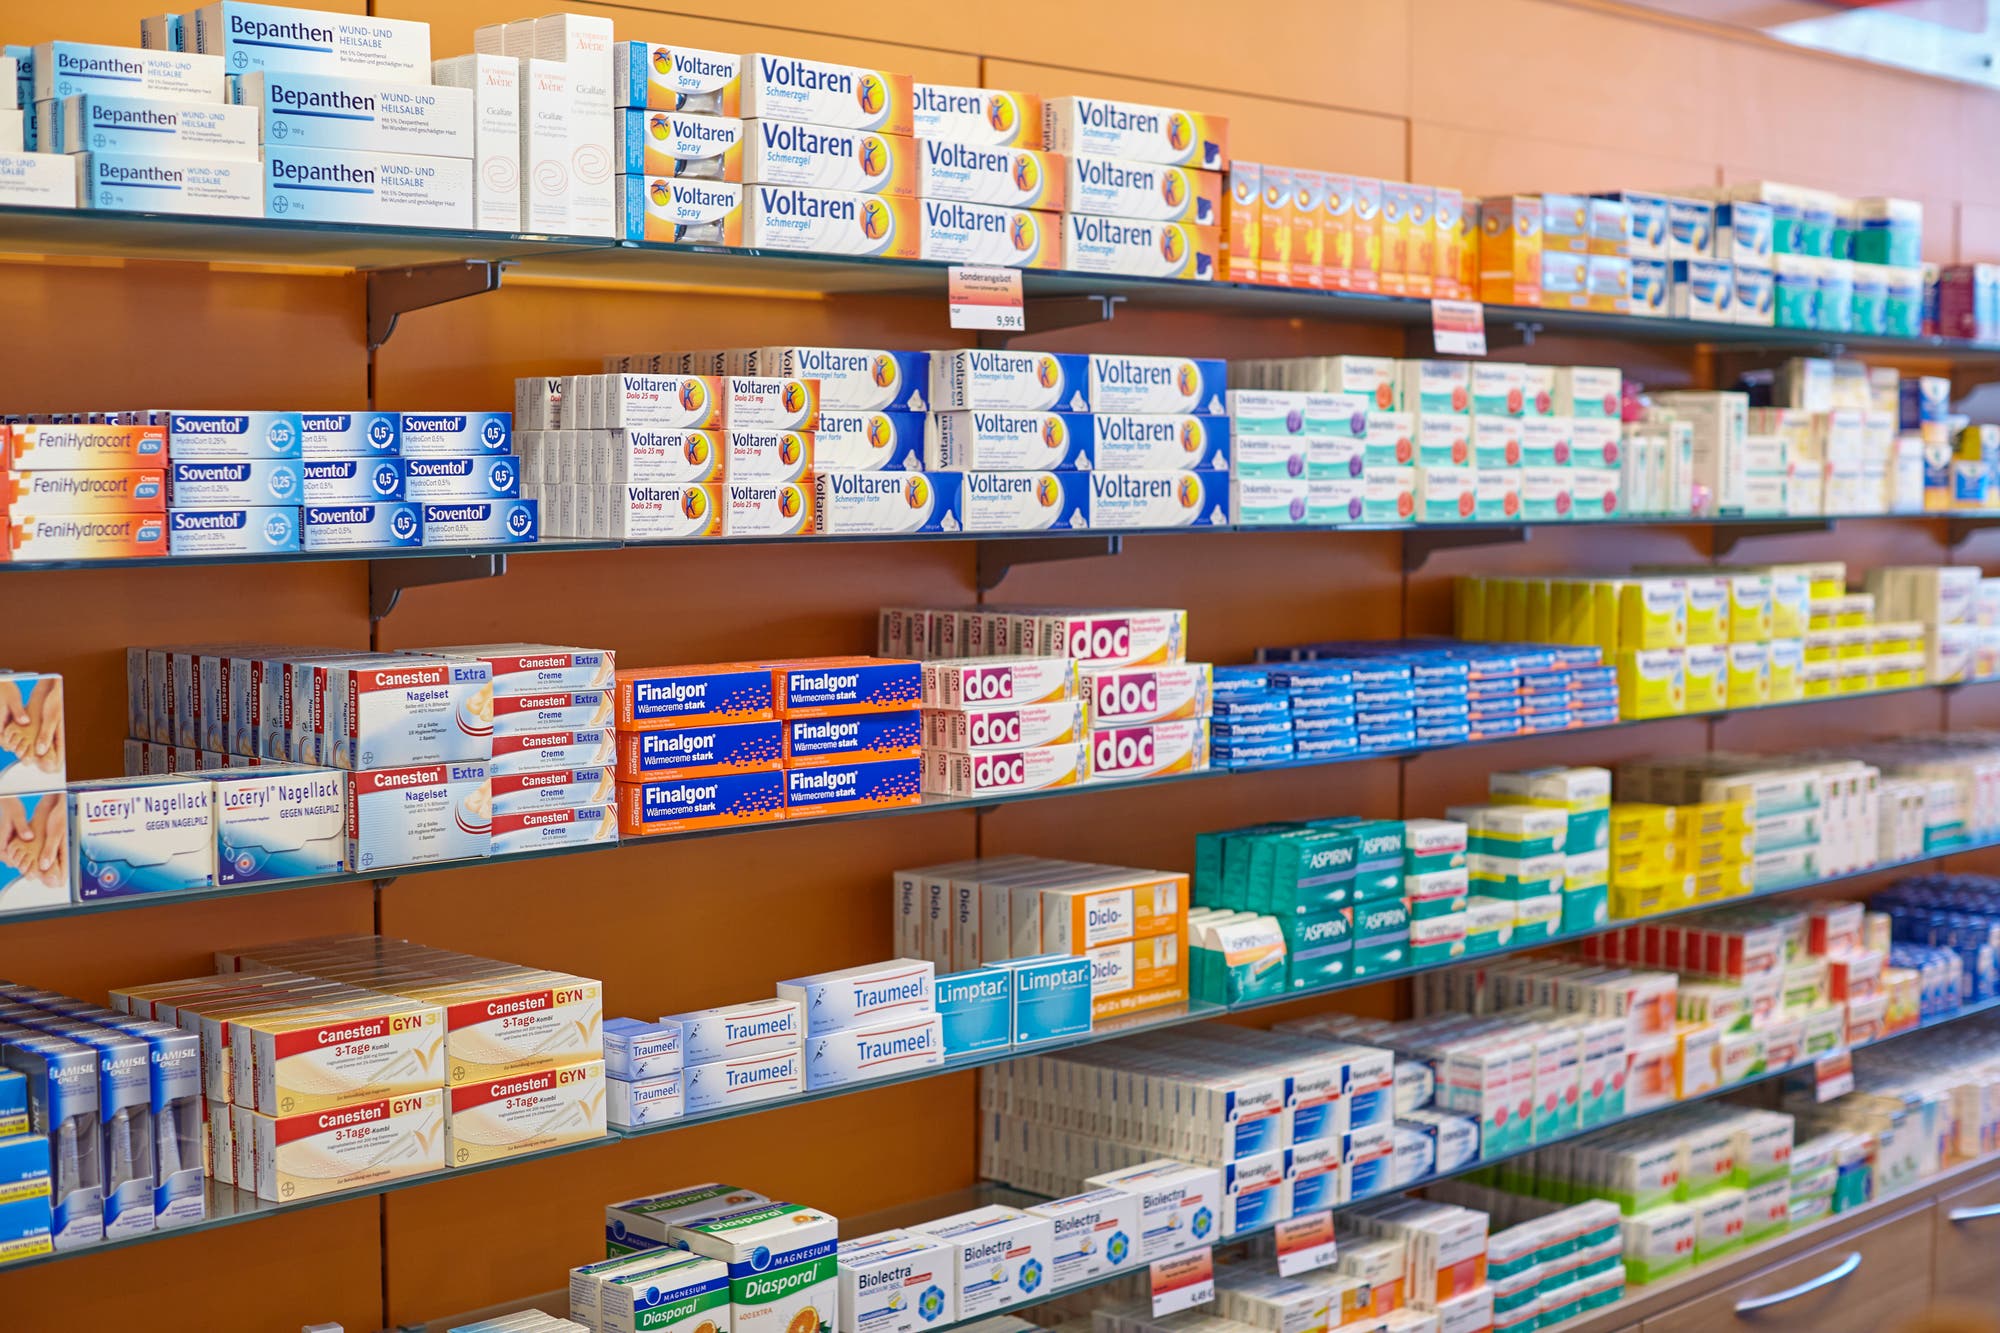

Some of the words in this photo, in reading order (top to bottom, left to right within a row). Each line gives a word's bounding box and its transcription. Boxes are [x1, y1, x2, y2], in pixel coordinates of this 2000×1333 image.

[231, 16, 334, 43] Bepanthen
[339, 25, 370, 37] WUND-
[373, 29, 392, 39] UND
[339, 37, 382, 48] HEILSALBE
[58, 54, 143, 75] Bepanthen
[674, 55, 733, 78] Voltaren
[678, 76, 700, 89] Spray
[761, 57, 851, 94] Voltaren
[272, 85, 374, 110] Bepanthen
[381, 92, 413, 103] WUND-
[415, 96, 435, 105] UND
[766, 85, 810, 102] Schmerzgel
[914, 87, 981, 115] oltaren
[93, 106, 177, 125] Bepanthen
[381, 104, 425, 116] HEILSALBE
[1079, 101, 1159, 133] Voltaren
[673, 120, 735, 143] Voltaren
[763, 123, 853, 158] Voltaren
[767, 151, 811, 167] Schmerzgel
[928, 141, 1008, 173] Voltaren
[100, 163, 182, 182] Bepanthen
[272, 159, 374, 183] Bepanthen
[931, 168, 971, 181] Schmerzgel
[1077, 159, 1154, 190] Voltaren
[673, 186, 734, 207] Voltaren
[763, 188, 855, 221] Voltaren
[677, 207, 700, 219] Spray
[927, 202, 1005, 233] Voltaren
[1073, 216, 1152, 246] Voltaren
[960, 272, 1011, 283] Sonderangebot
[997, 316, 1014, 327] 9,99
[1017, 317, 1021, 326] €
[799, 350, 867, 371] Voltaren
[970, 353, 1032, 373] Voltaren
[1096, 360, 1171, 384] Voltaren
[624, 378, 677, 393] Voltaren
[733, 381, 780, 393] Voltaren
[650, 394, 658, 402] mg
[177, 416, 240, 433] Soventol
[406, 418, 458, 431] Soventol
[975, 414, 1037, 433] Voltaren
[1099, 418, 1174, 441] Voltaren
[39, 432, 132, 450] FeniHydrocort
[631, 432, 681, 447] Voltaren
[732, 433, 778, 448] Voltaren
[179, 463, 237, 481] Soventol
[411, 461, 464, 475] Soventol
[34, 477, 127, 495] FeniHydrocort
[731, 487, 776, 500] Voltaren
[831, 475, 900, 495] Voltaren
[968, 475, 1031, 493] Voltaren
[1093, 475, 1171, 497] Voltaren
[629, 488, 679, 501] Voltaren
[835, 495, 865, 503] Schmerzgel
[177, 511, 239, 529] Soventol
[310, 508, 366, 524] Soventol
[428, 505, 483, 520] Soventol
[37, 521, 130, 539] FeniHydrocort
[1071, 622, 1129, 659] doc
[519, 656, 565, 669] Canesten
[575, 655, 598, 665] Extra
[375, 672, 440, 686] Canesten
[455, 668, 486, 681] Extra
[538, 671, 562, 680] Creme
[791, 674, 856, 694] Finalgon
[407, 689, 448, 701] Nagelset
[638, 683, 704, 705] Finalgon
[965, 670, 1011, 701] doc
[520, 696, 565, 708] Canesten
[575, 694, 598, 704] Extra
[1099, 676, 1156, 715] doc
[538, 710, 562, 719] Creme
[638, 702, 683, 713] Wärmecreme
[684, 700, 705, 710] stark
[794, 723, 858, 743] Finalgon
[972, 713, 1019, 744] doc
[522, 734, 566, 747] Canesten
[644, 734, 712, 755] Finalgon
[1095, 730, 1153, 770] doc
[541, 749, 564, 758] Creme
[374, 771, 438, 788] Canesten
[452, 767, 484, 780] Extra
[522, 772, 566, 785] Canesten
[791, 771, 855, 792] Finalgon
[224, 788, 270, 808] Loceryl
[279, 780, 338, 804] Nagellack
[405, 789, 447, 801] Nagelset
[646, 785, 715, 806] Finalgon
[86, 799, 135, 820] Loceryl
[145, 791, 208, 815] Nagellack
[280, 807, 302, 819] GEGEN
[304, 803, 339, 816] NAGELPILZ
[146, 820, 169, 832] GEGEN
[172, 815, 208, 828] NAGELPILZ
[523, 812, 568, 825] Canesten
[1364, 835, 1401, 854] ASPIRIN
[1310, 847, 1352, 869] ASPIRIN
[961, 888, 970, 924] Diclo
[1089, 911, 1121, 926] Diclo-
[1365, 909, 1405, 929] ASPIRIN
[1304, 919, 1346, 941] ASPIRIN
[1020, 968, 1085, 991] Limptar
[854, 987, 923, 1008] Traumeel
[938, 980, 1002, 1004] Limptar
[487, 996, 545, 1015] Canesten
[556, 989, 583, 1004] GYN
[318, 1024, 380, 1044] Canesten
[393, 1016, 421, 1032] GYN
[503, 1014, 535, 1028] 3-Tage
[725, 1016, 792, 1040] Traumeel
[335, 1043, 370, 1057] 3-Tage
[633, 1042, 675, 1057] Traumeel
[857, 1030, 930, 1060] Traumeel
[106, 1055, 146, 1071] LAMISIL
[156, 1048, 196, 1063] LAMISIL
[54, 1063, 95, 1078] LAMISIL
[726, 1062, 792, 1086] Traumeel
[491, 1076, 548, 1097] Canesten
[560, 1068, 586, 1084] GYN
[1297, 1078, 1331, 1095] Neuralgin
[634, 1087, 676, 1102] Traumeel
[1238, 1091, 1272, 1110] Neuralgin
[319, 1106, 381, 1128] Canesten
[393, 1098, 421, 1114] GYN
[1143, 1188, 1185, 1208] Biolectra
[1054, 1212, 1100, 1234] Biolectra
[774, 1244, 831, 1266] MAGNESIUM
[964, 1240, 1012, 1263] Biolectra
[745, 1265, 818, 1299] Diasporal
[859, 1266, 911, 1289] Biolectra
[663, 1284, 707, 1302] MAGNESIUM
[643, 1302, 697, 1327] Diasporal
